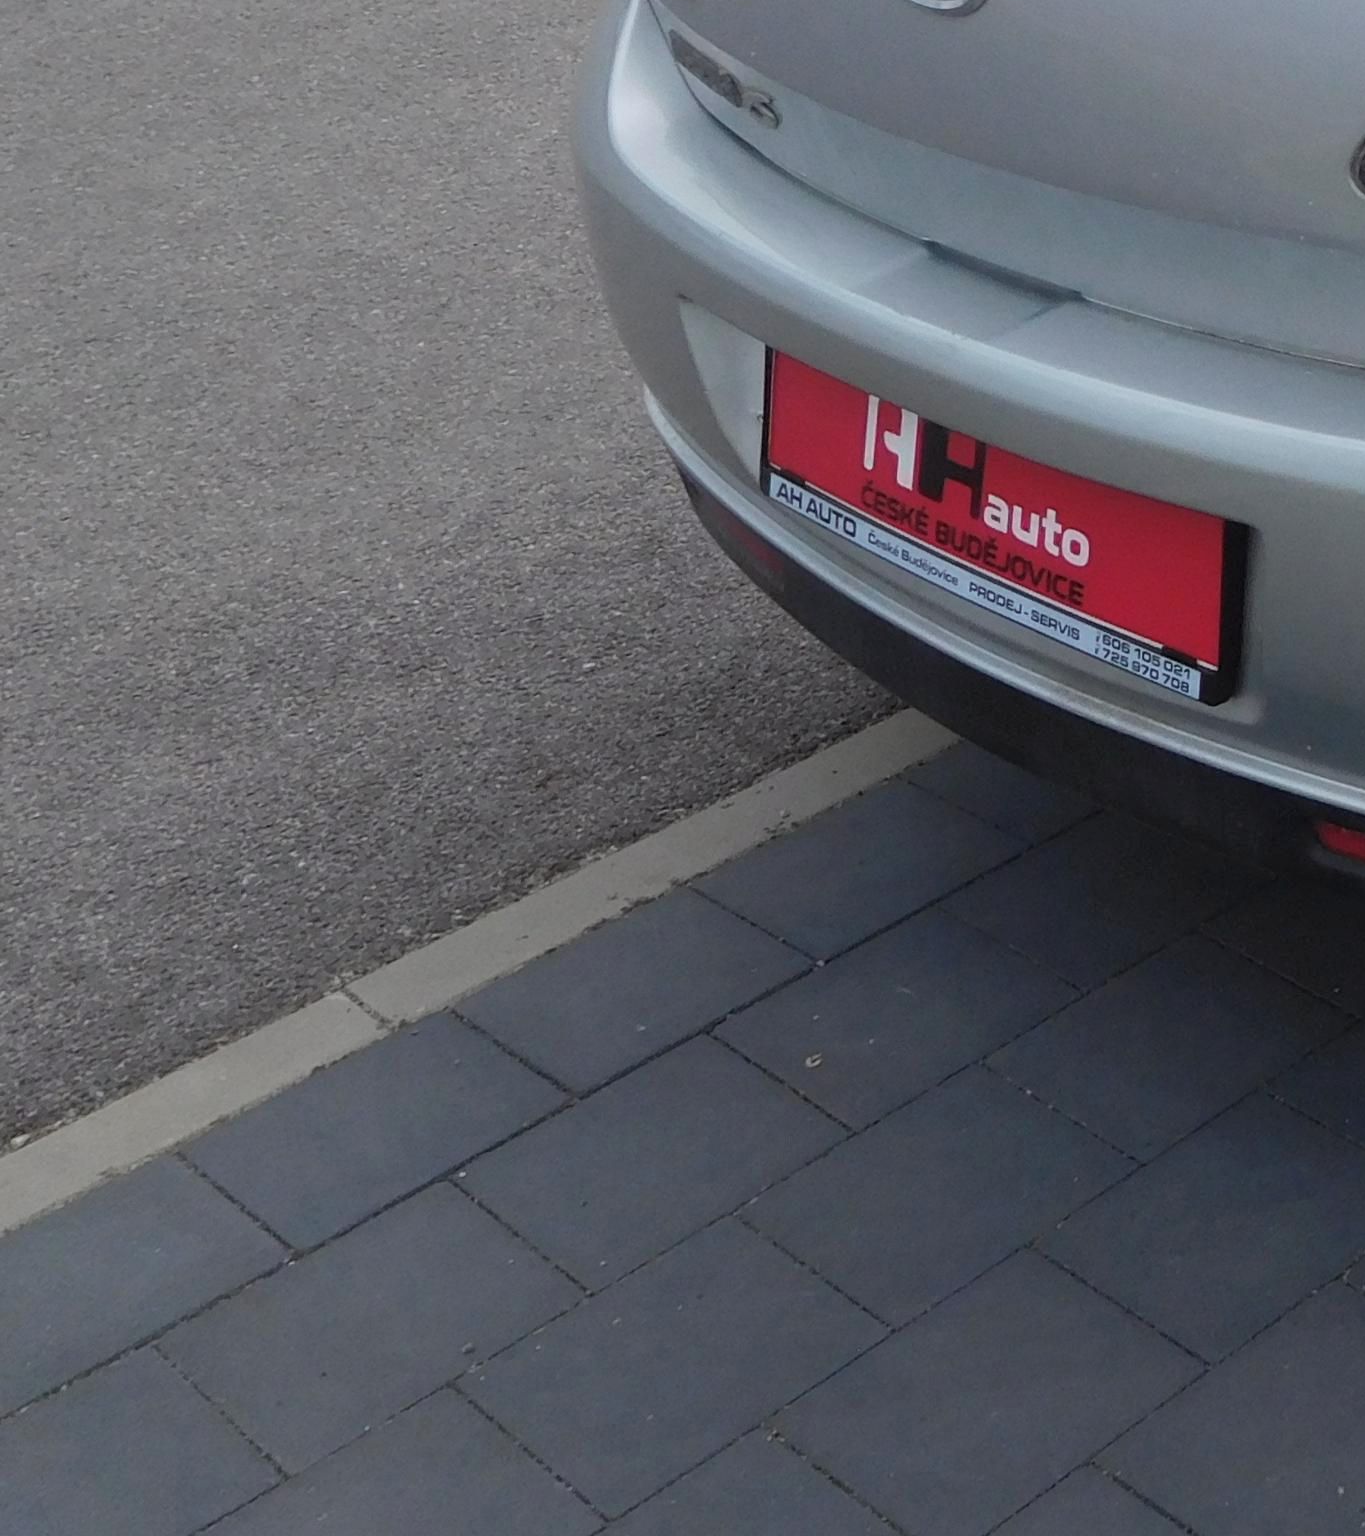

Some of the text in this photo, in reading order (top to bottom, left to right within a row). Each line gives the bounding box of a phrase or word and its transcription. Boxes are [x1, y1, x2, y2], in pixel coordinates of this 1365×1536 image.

[776, 483, 802, 509] AH
[806, 500, 857, 538] AUTO
[861, 480, 1085, 607] ČESKÉ BUDĚJOVICE
[1102, 634, 1191, 680] 606 105 021
[1102, 647, 1129, 668] 725
[1163, 674, 1190, 693] 708
